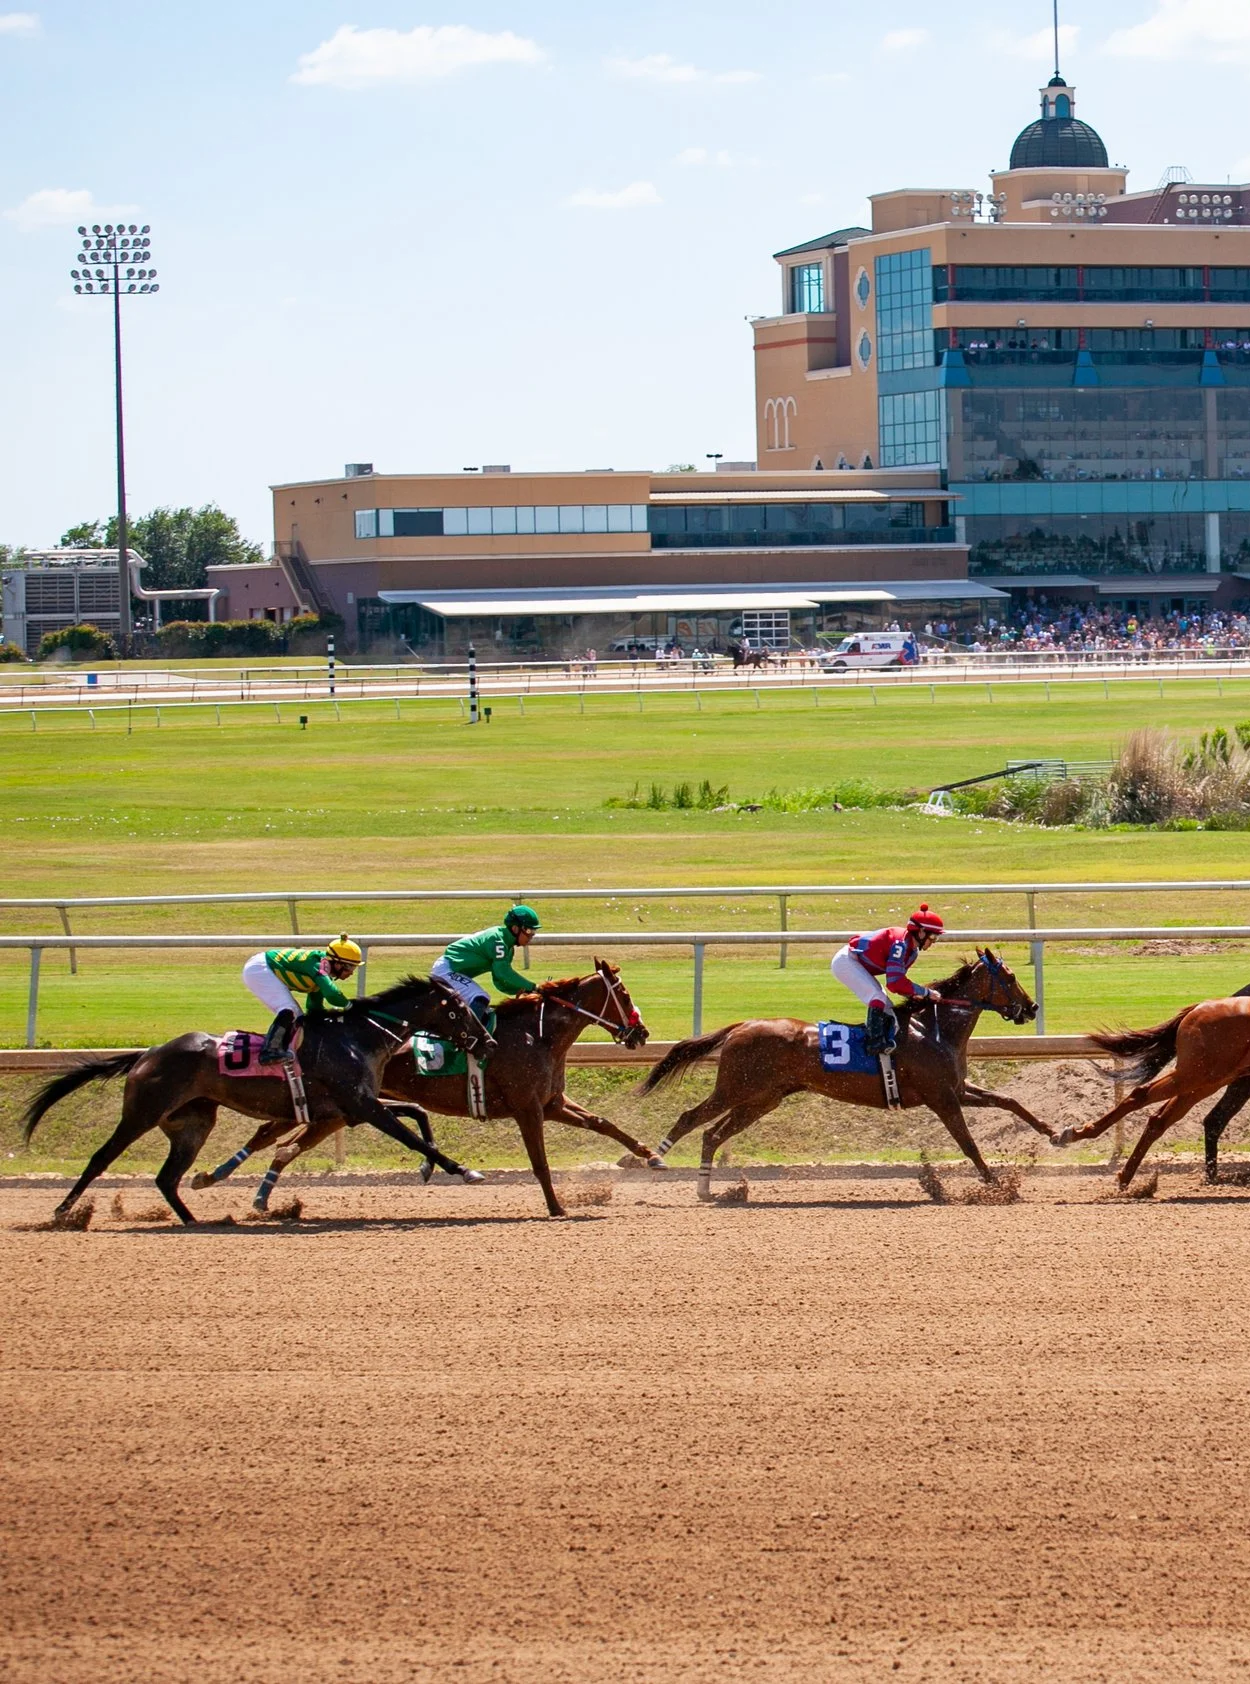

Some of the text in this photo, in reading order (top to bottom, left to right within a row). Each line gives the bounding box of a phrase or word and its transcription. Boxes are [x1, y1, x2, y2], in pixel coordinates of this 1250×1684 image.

[495, 945, 505, 959] 5
[892, 945, 903, 959] 3
[416, 1035, 445, 1071] 5
[822, 1024, 851, 1065] 3
